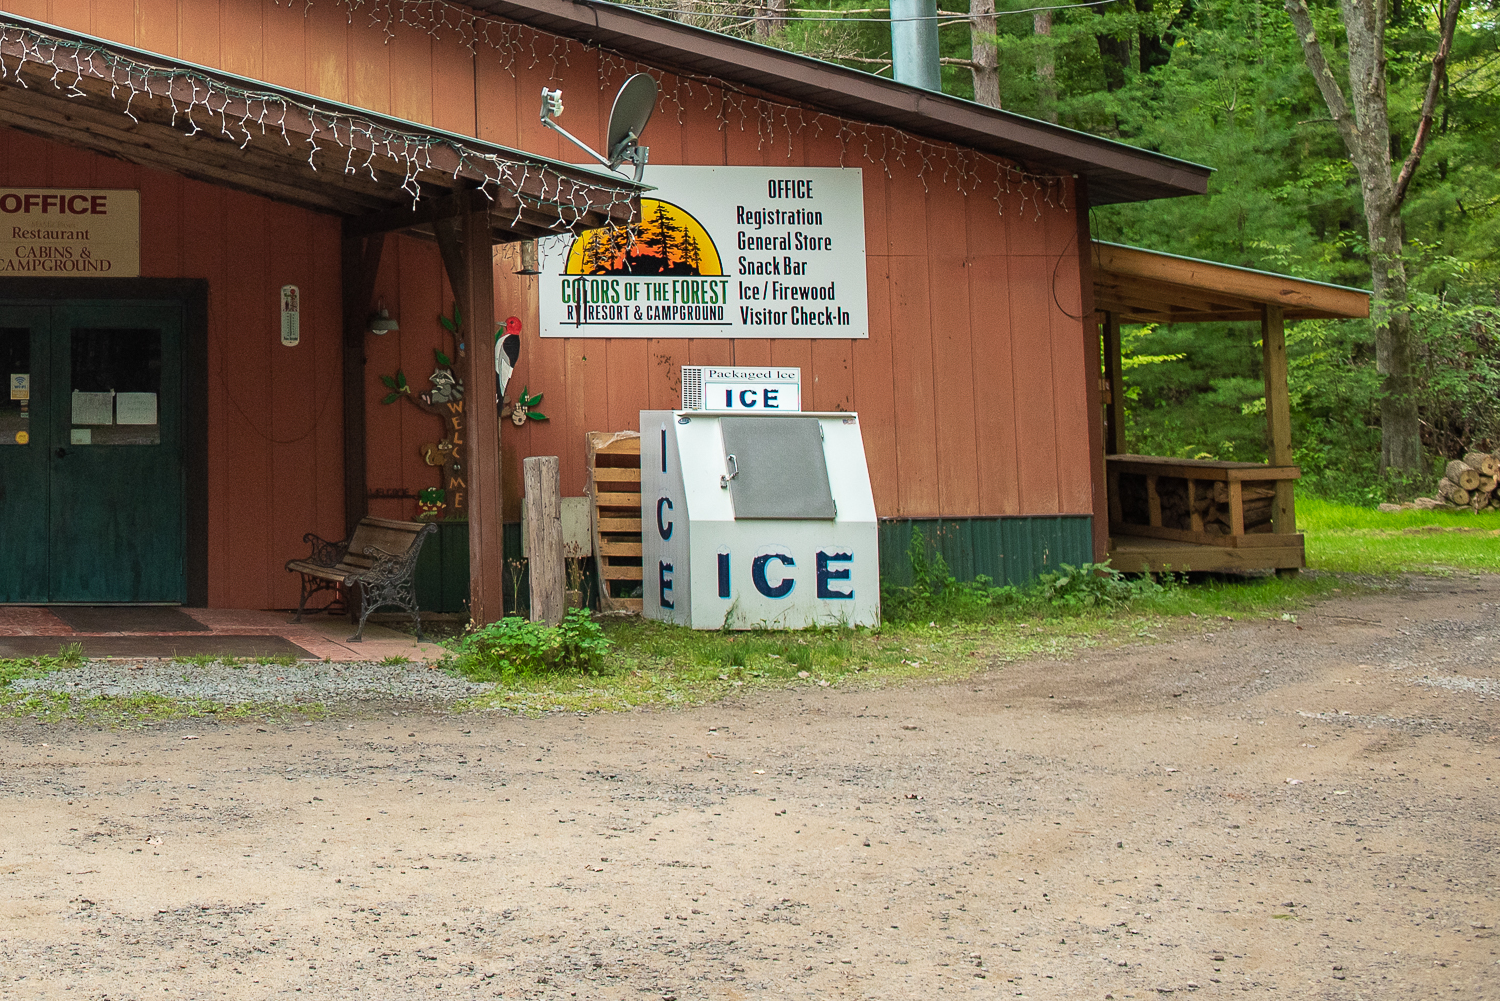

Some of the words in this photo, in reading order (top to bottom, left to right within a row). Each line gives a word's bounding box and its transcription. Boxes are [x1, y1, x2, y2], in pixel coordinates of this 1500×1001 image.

[768, 179, 813, 199] OFFICE
[0, 193, 107, 215] OFFICE
[736, 205, 823, 230] Registration
[12, 226, 90, 240] Restaurant
[737, 231, 791, 251] General
[794, 231, 832, 251] Store
[15, 245, 73, 259] CABINS
[80, 246, 91, 259] &
[738, 255, 781, 276] Snack
[783, 256, 807, 276] Bar
[561, 279, 620, 304] COLORS
[624, 282, 641, 301] OF
[644, 282, 670, 301] THE
[672, 279, 729, 304] FOREST
[739, 280, 760, 300] Ice
[763, 281, 768, 300] /
[772, 281, 836, 300] Firewood
[588, 305, 630, 321] RESORT
[633, 305, 643, 321] &
[646, 305, 724, 321] CAMPGROUND
[740, 305, 788, 325] Visitor
[791, 306, 850, 325] Check-In
[709, 369, 771, 380] Packaged
[777, 370, 795, 379] Ice
[726, 388, 779, 408] ICE
[656, 424, 674, 610] ICE
[717, 547, 855, 600] ICE
